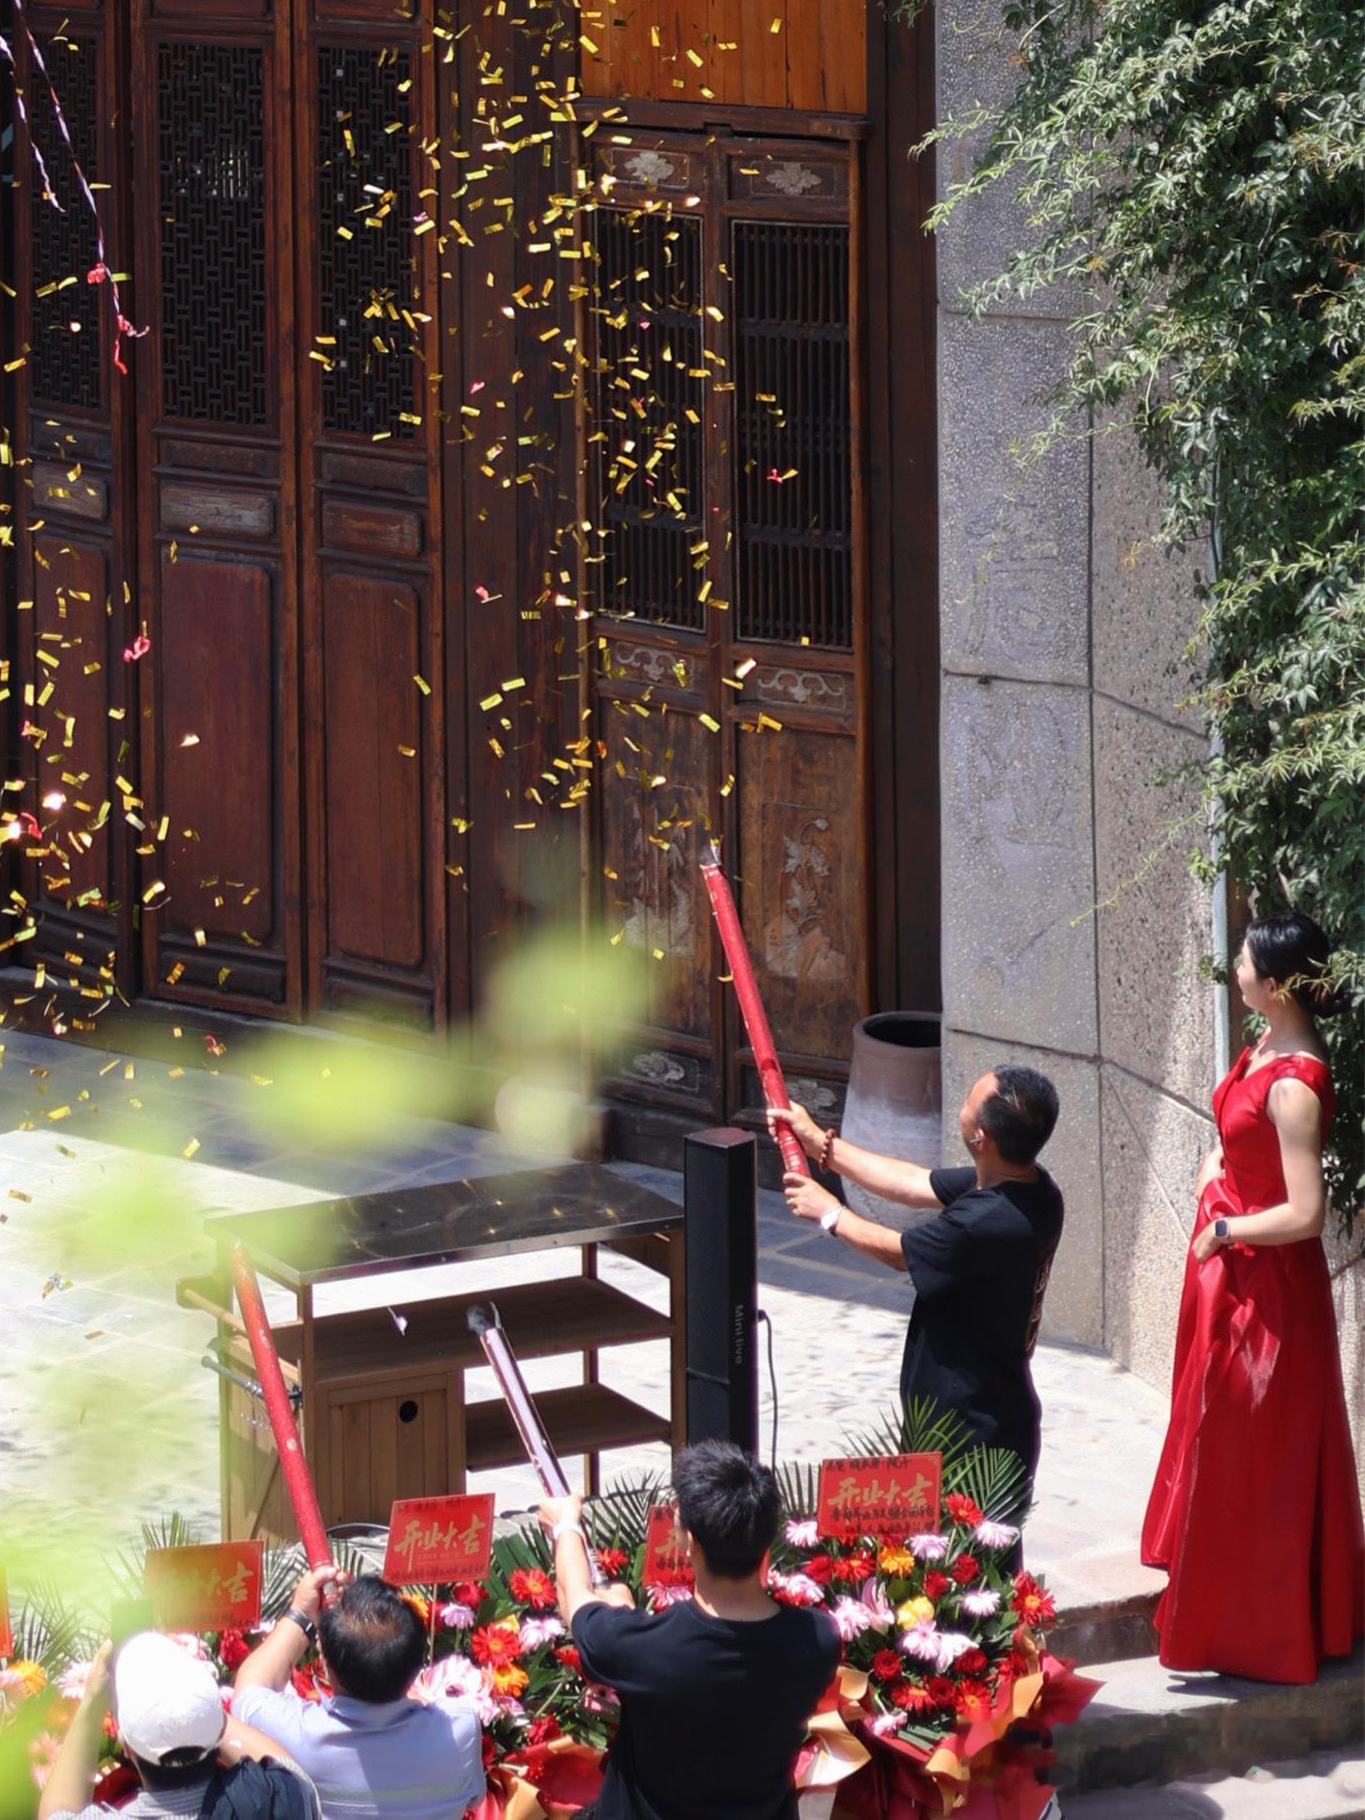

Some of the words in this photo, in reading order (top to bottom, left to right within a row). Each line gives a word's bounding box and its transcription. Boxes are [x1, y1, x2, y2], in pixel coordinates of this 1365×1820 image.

[826, 1471, 933, 1525] 开业大吉
[394, 1513, 486, 1573] 开业大吉
